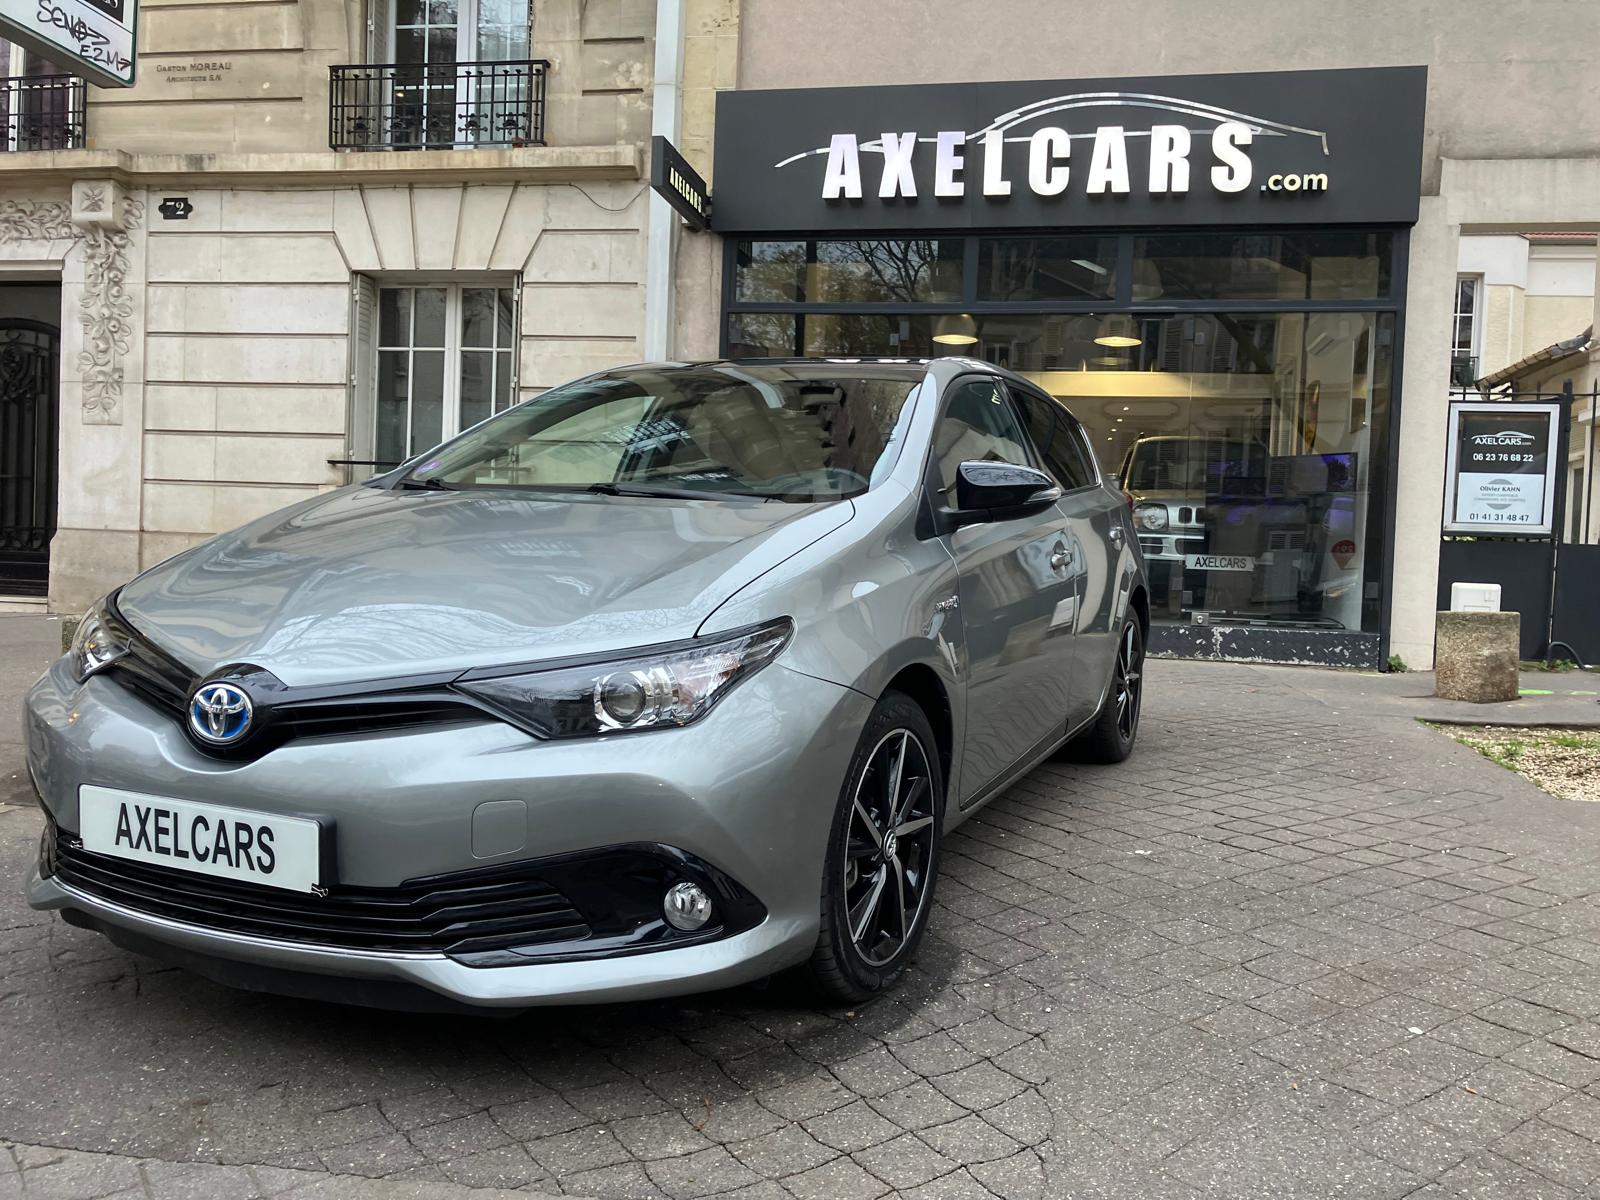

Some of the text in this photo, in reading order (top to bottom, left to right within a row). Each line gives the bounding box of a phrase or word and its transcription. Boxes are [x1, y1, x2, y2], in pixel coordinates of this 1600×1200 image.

[190, 62, 232, 71] MOREAU
[669, 167, 702, 213] AXELCARS
[1473, 453, 1483, 461] 06
[1485, 453, 1496, 461] 23
[1523, 454, 1533, 462] 22
[1194, 556, 1247, 569] AXELCARS
[115, 803, 275, 874] AXELCARS
